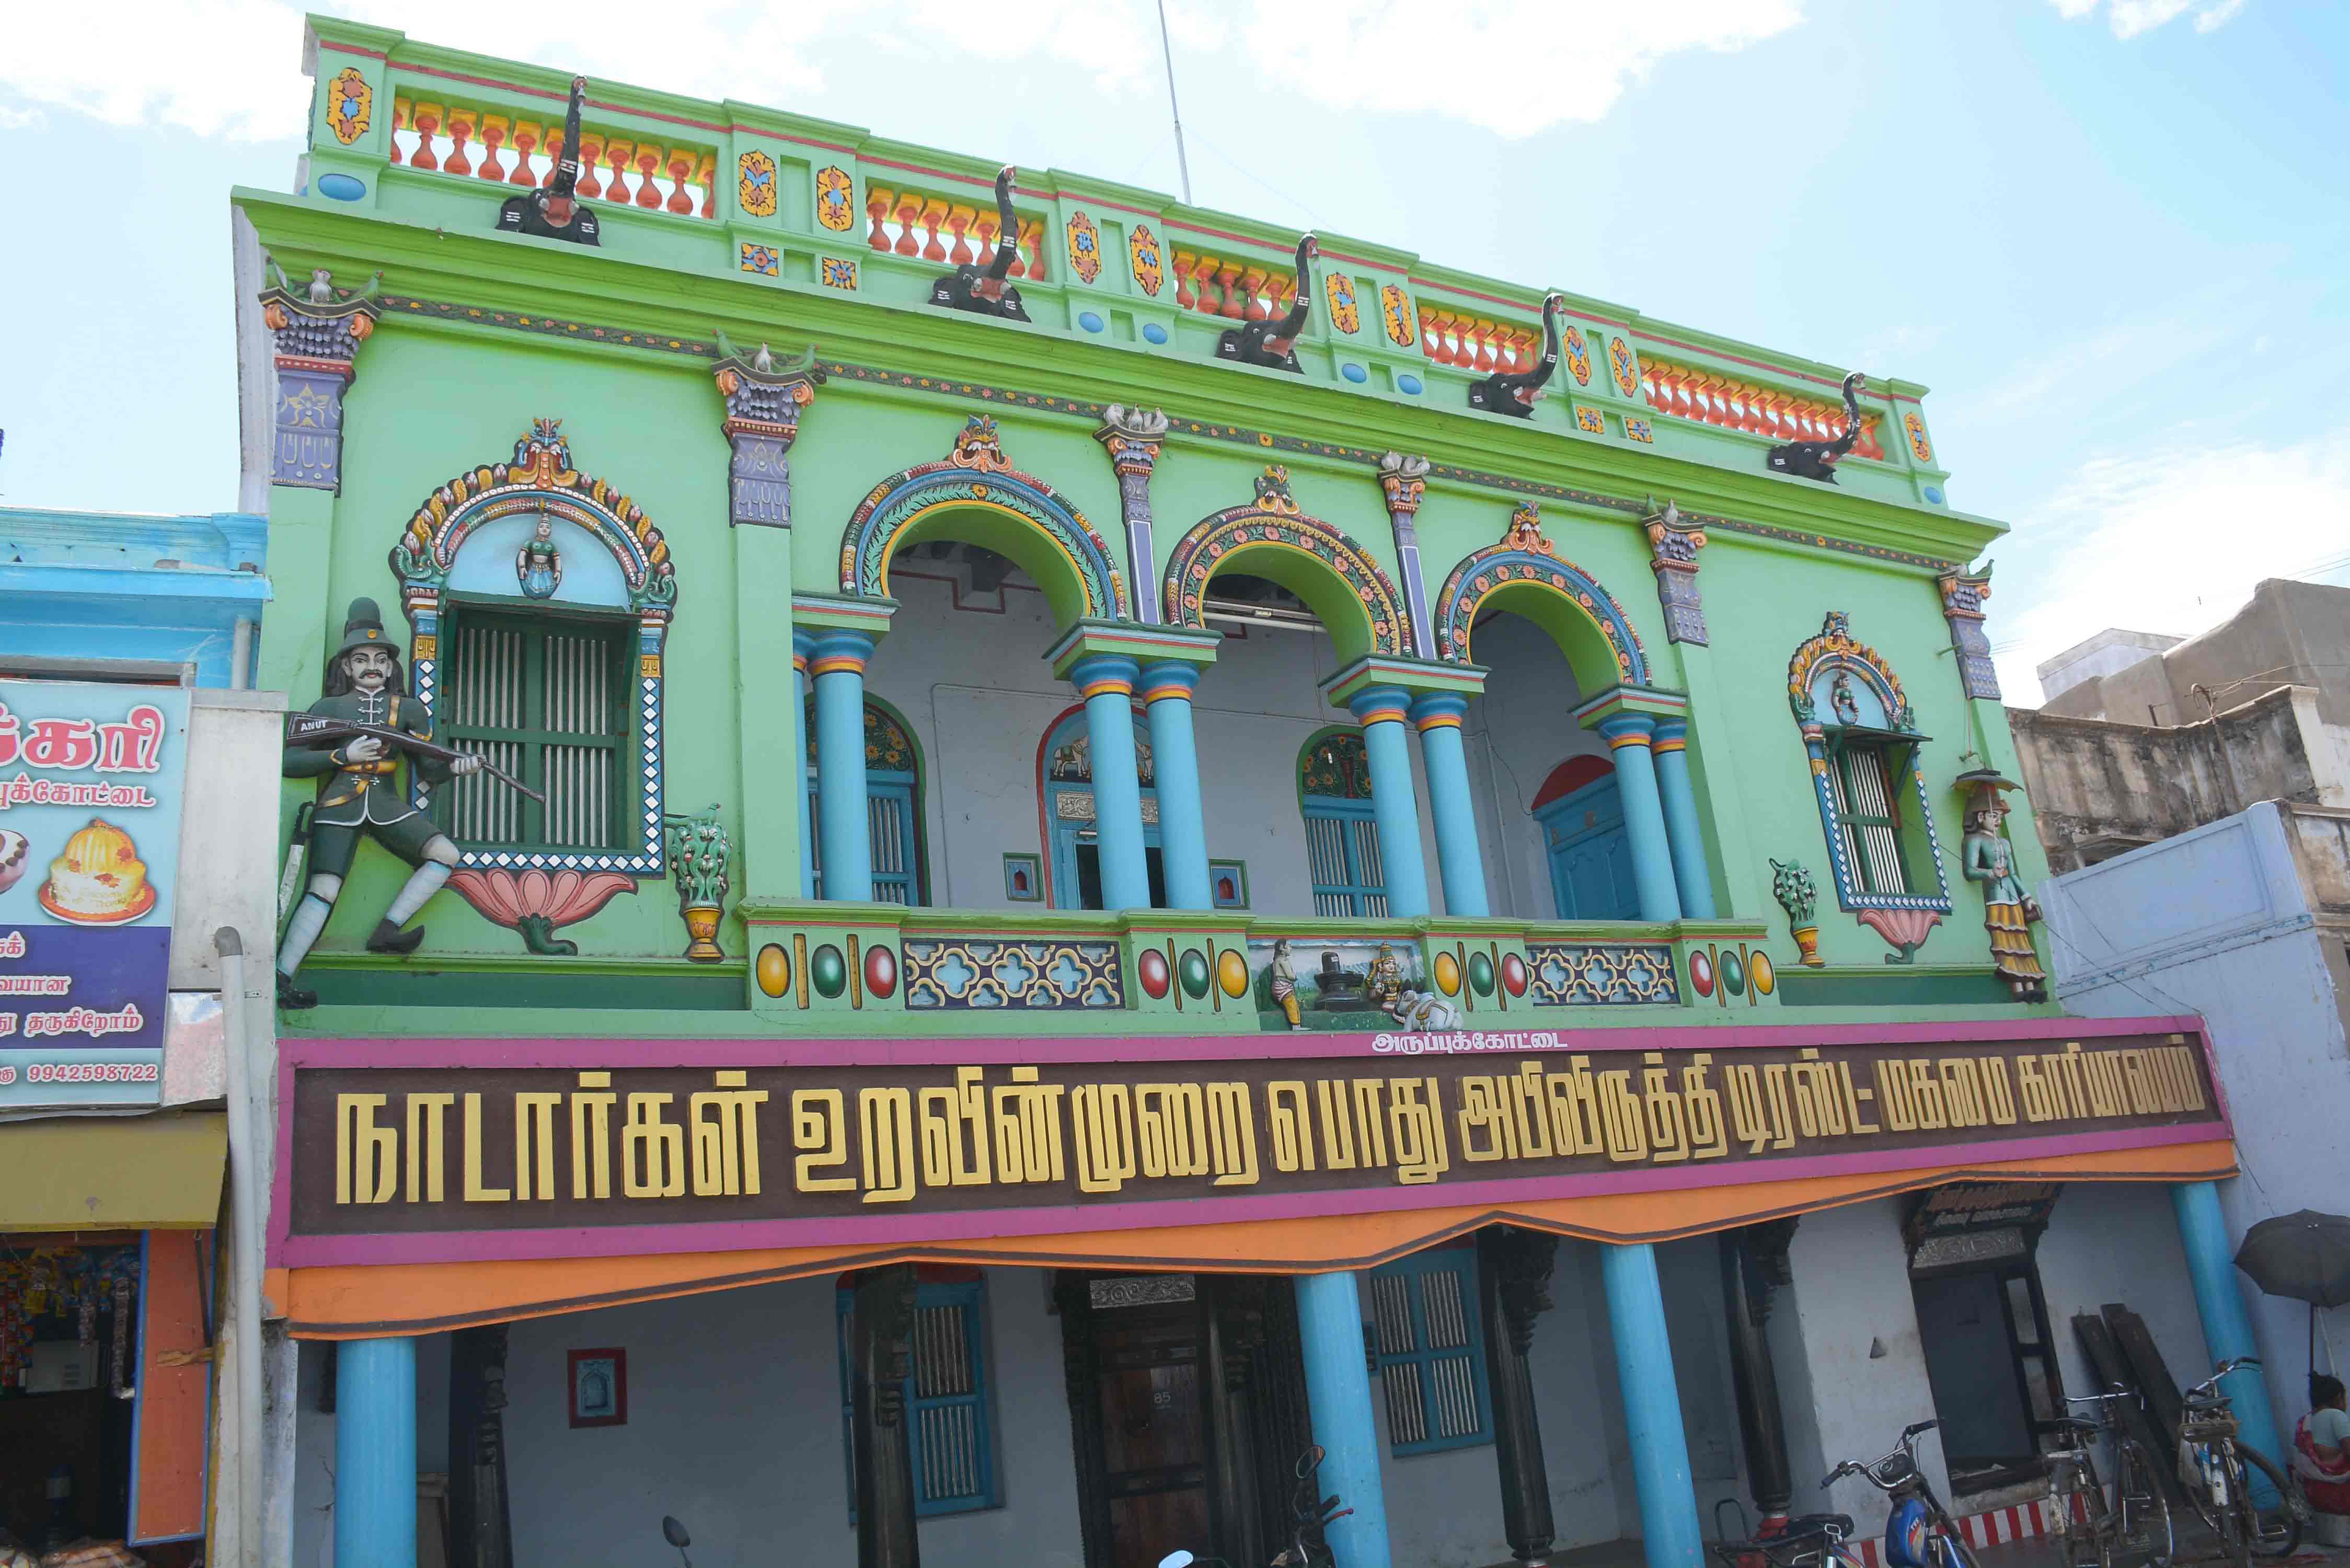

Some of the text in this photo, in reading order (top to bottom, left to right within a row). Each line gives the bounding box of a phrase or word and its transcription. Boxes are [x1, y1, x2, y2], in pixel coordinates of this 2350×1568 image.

[27, 1006, 141, 1035] தருகிறோம்
[1372, 1031, 1569, 1055] அருப்புக்கோட்டை
[28, 1065, 157, 1080] 9942598722
[336, 1070, 769, 1204] நாடார்கள்
[1267, 1077, 1450, 1185] பொது
[1459, 1053, 1728, 1162] அபிவிருத்தி
[2017, 1034, 2206, 1123] காரியாலயம்
